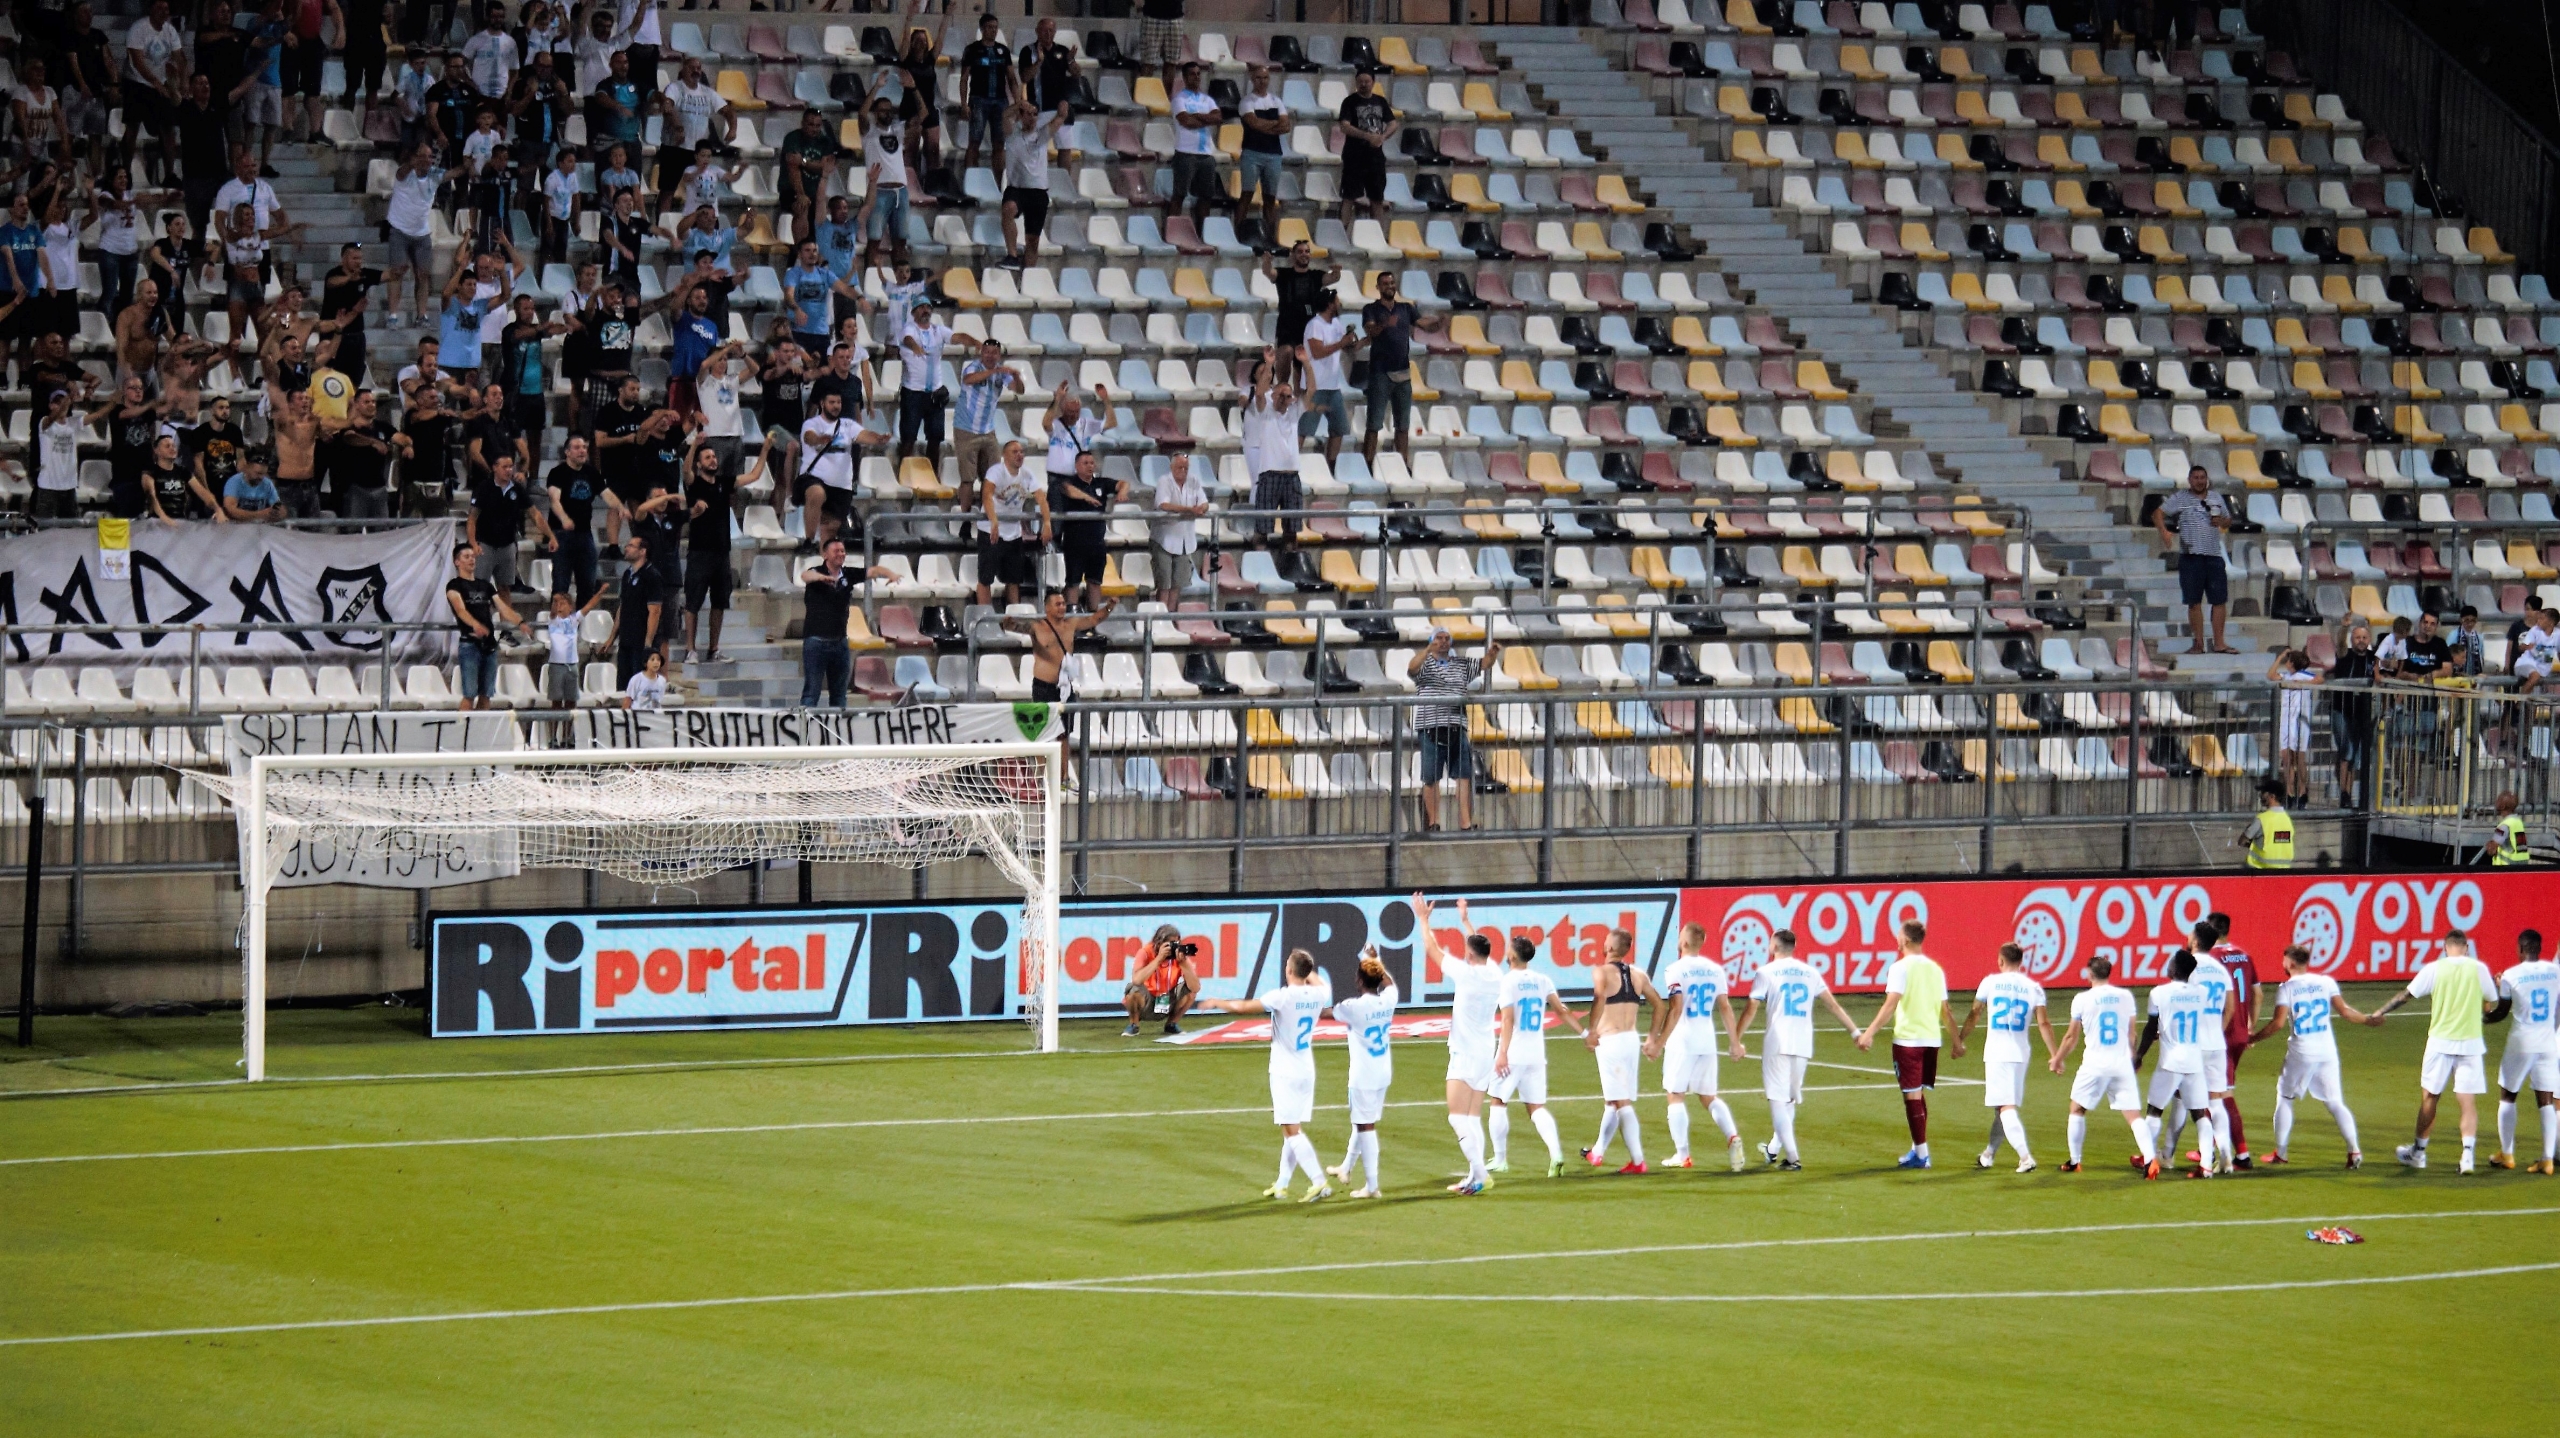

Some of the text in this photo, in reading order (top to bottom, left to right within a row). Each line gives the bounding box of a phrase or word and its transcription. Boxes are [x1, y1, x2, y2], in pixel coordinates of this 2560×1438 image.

[335, 587, 349, 600] NK
[422, 716, 471, 752] TI
[664, 710, 765, 748] TRUTH
[772, 714, 800, 747] IS
[1720, 890, 1928, 948] YOYO
[2013, 884, 2212, 944] YOYO
[2293, 880, 2484, 938] YOYO
[1686, 983, 1716, 1018] 36
[1780, 983, 1809, 1017] 12
[2095, 996, 2120, 1005] LIBER
[2170, 995, 2201, 1004] PRINCE
[2232, 967, 2246, 1003] 1
[1295, 1001, 1319, 1010] BRAUT
[1517, 997, 1543, 1032] 16
[1991, 996, 2029, 1032] 23
[2293, 998, 2329, 1035] 22
[2531, 988, 2549, 1021] 9
[1296, 1016, 1313, 1051] 2
[2099, 1011, 2119, 1046] 8
[2173, 1010, 2198, 1044] 11
